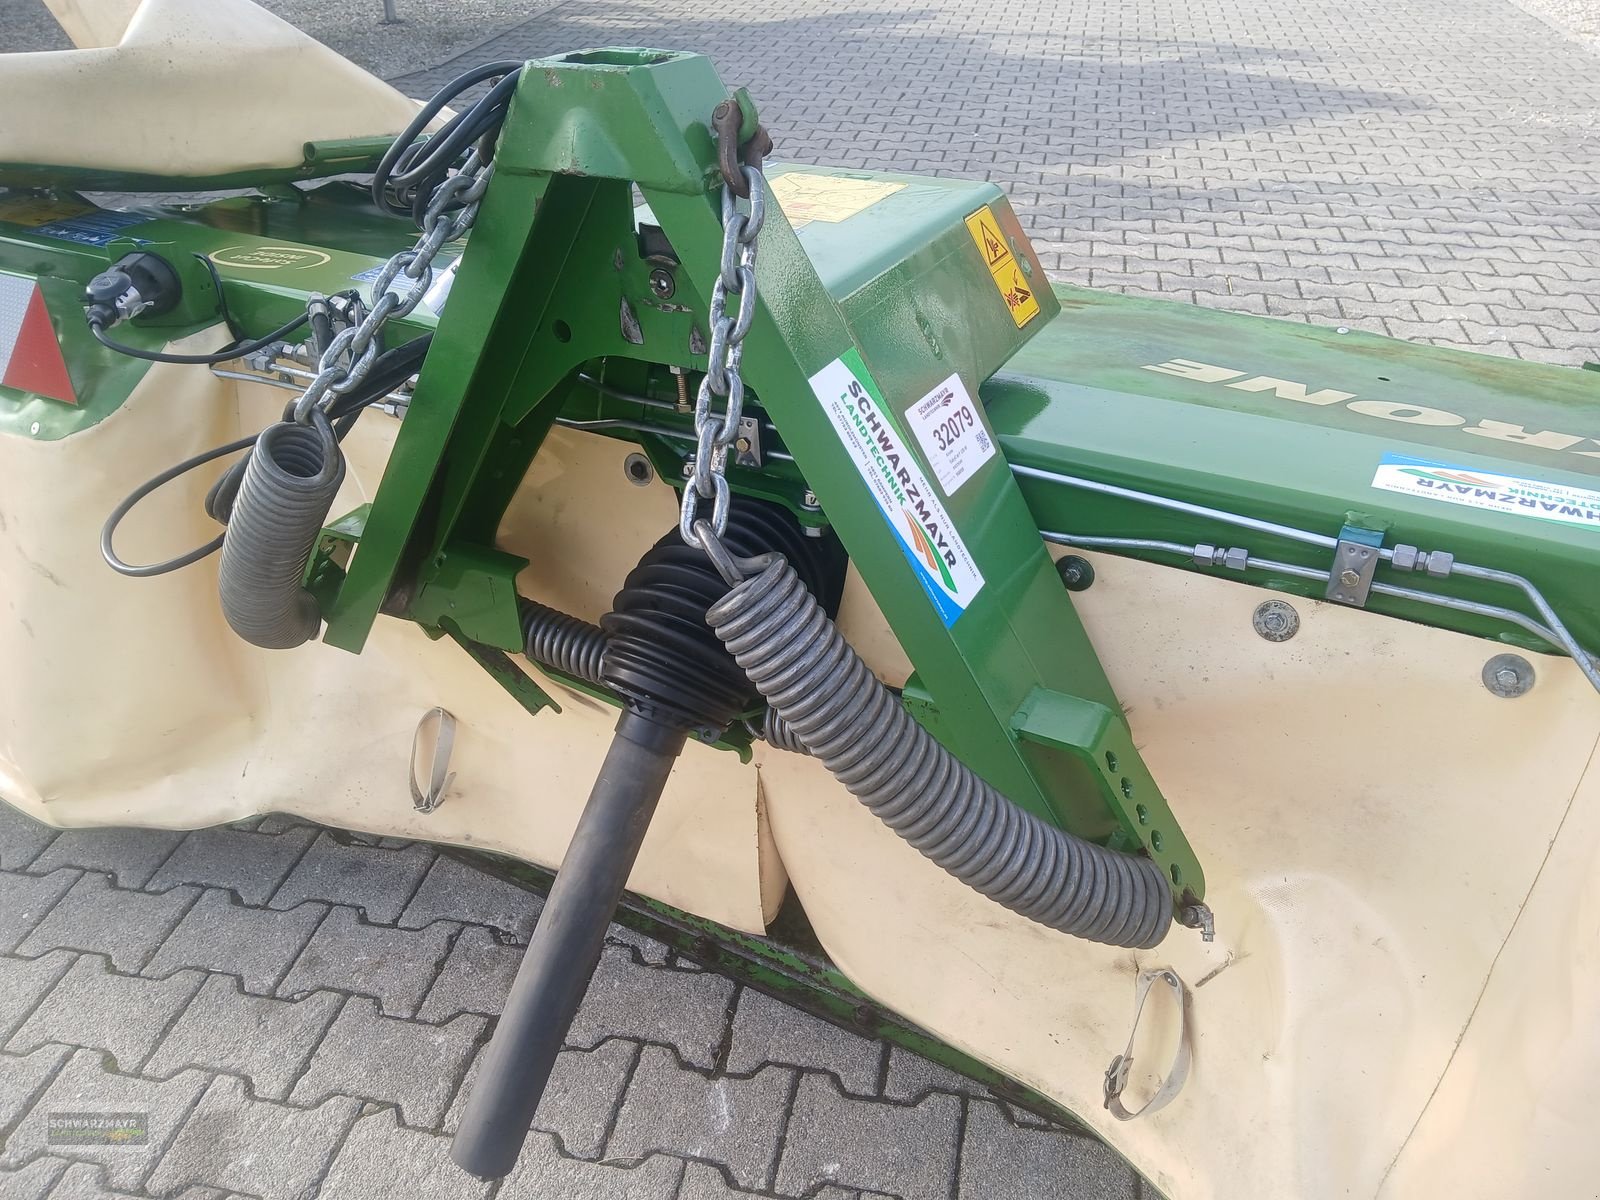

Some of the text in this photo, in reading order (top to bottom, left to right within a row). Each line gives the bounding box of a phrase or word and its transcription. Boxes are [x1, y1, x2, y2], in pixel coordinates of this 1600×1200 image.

[917, 386, 950, 416] SCHWARZMAYR
[931, 405, 975, 451] 32079
[840, 392, 907, 506] LANDTECHNIK
[847, 379, 958, 572] SCHWARZMAYR
